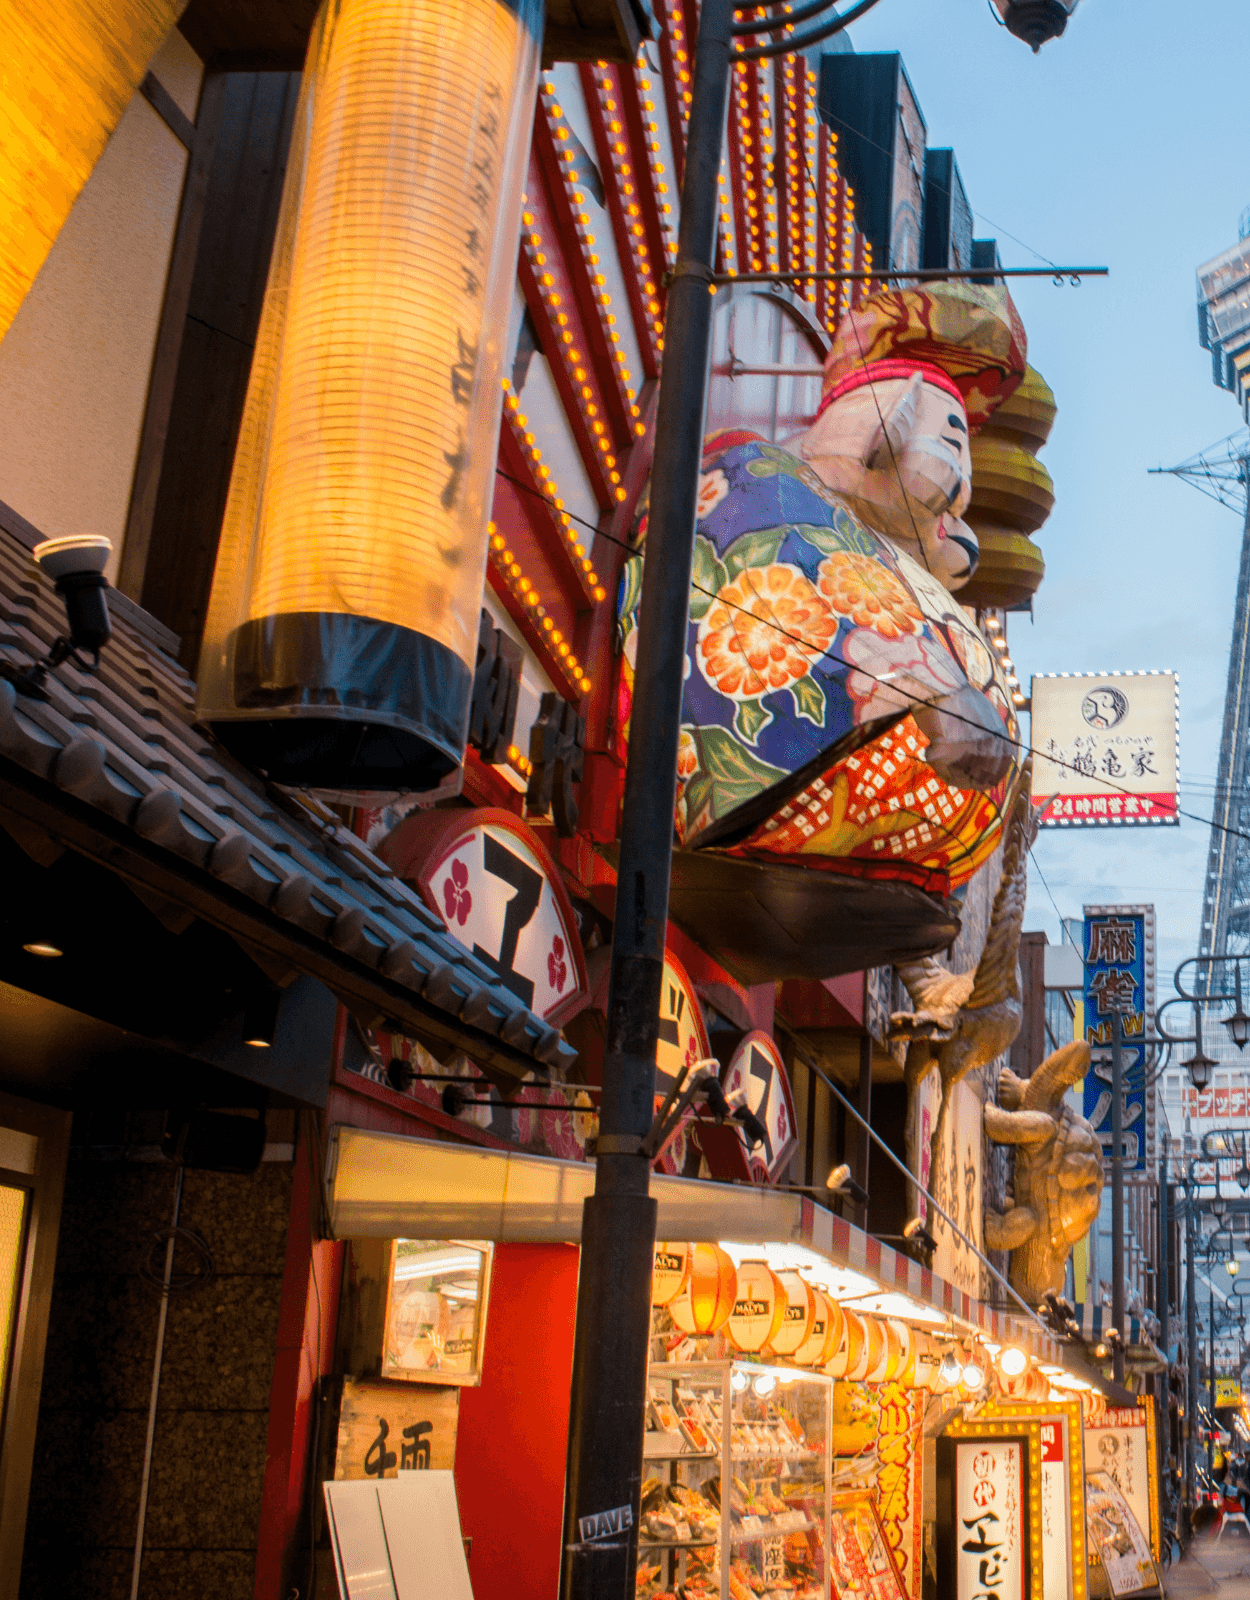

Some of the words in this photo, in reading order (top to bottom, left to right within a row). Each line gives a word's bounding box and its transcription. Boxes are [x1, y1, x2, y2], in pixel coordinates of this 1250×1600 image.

[1052, 797, 1153, 815] 24時間営業中
[1087, 917, 1138, 1015] 麻雀
[735, 1303, 765, 1314] MALT'S
[583, 1504, 632, 1540] DAVE
